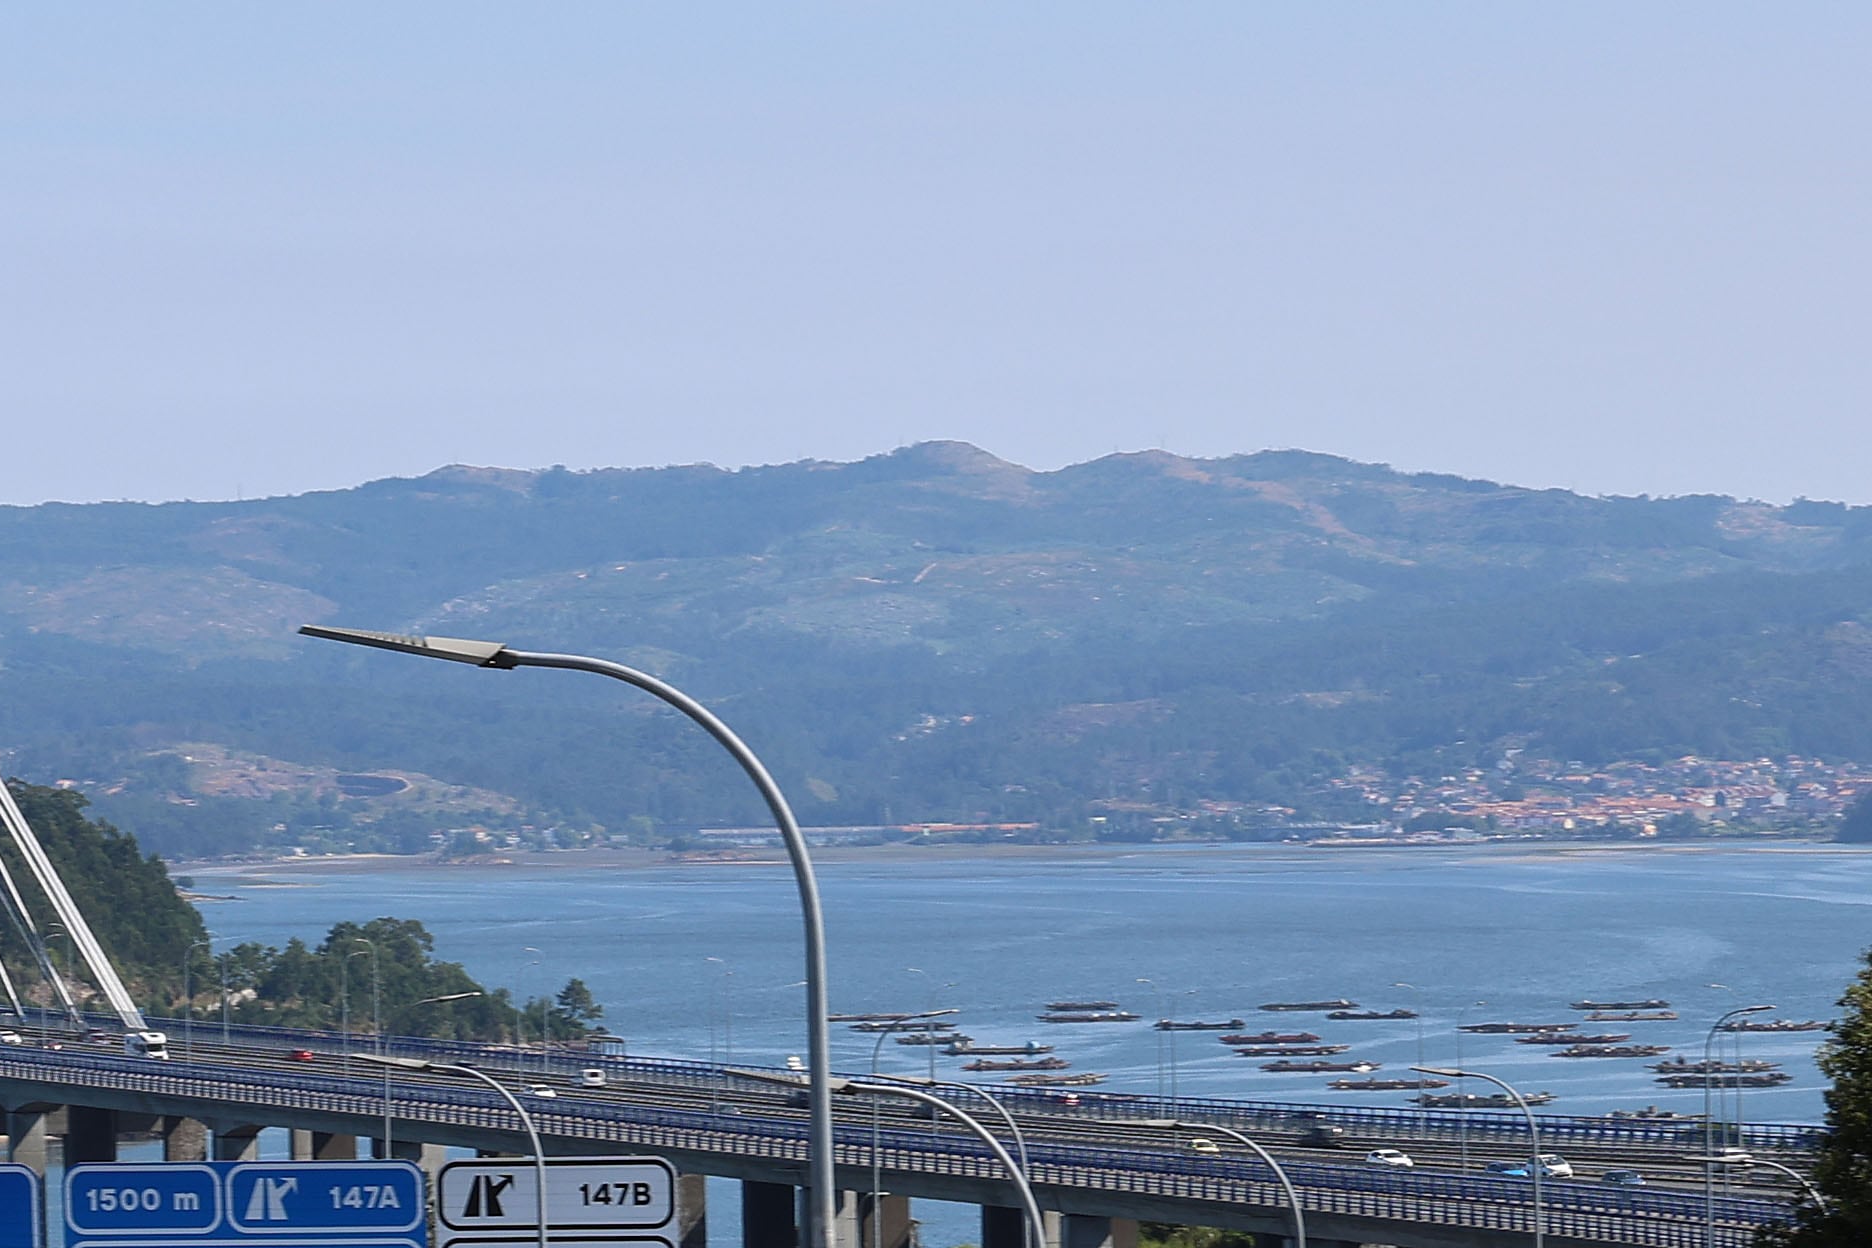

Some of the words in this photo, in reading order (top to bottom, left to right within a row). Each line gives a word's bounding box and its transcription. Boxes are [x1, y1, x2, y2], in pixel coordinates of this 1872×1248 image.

[86, 1188, 161, 1211] 1500
[173, 1192, 200, 1211] m
[329, 1185, 401, 1209] 147A
[579, 1182, 652, 1207] 147B
